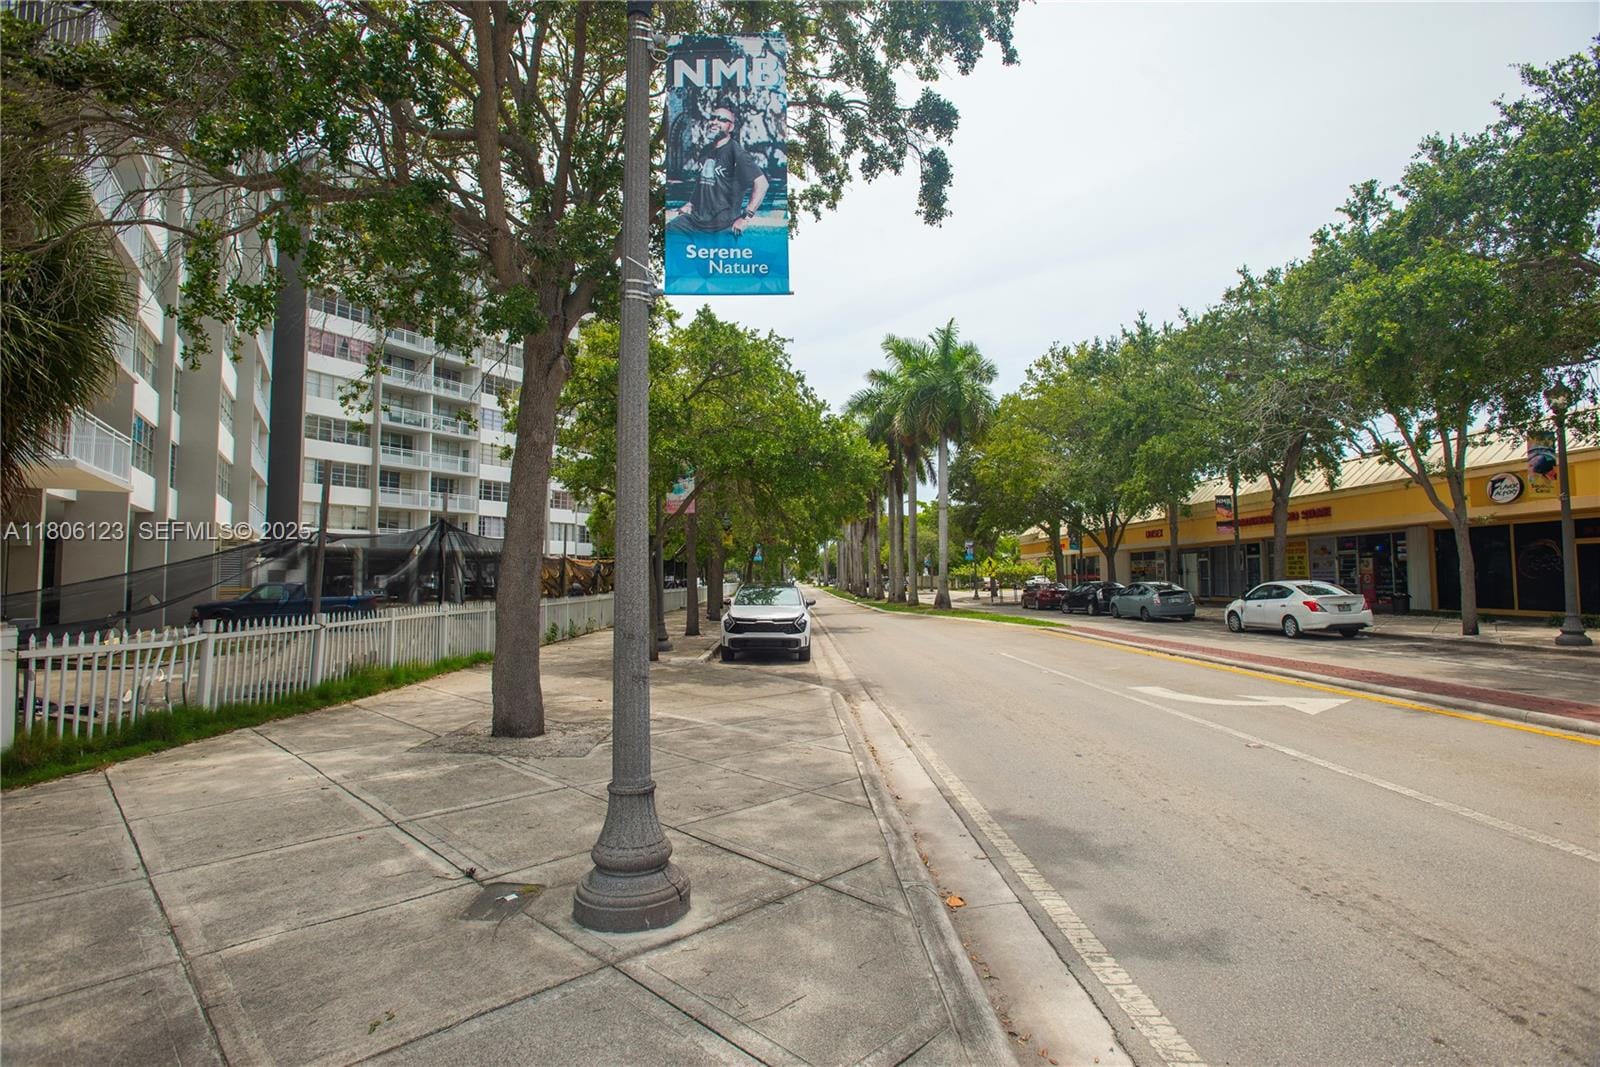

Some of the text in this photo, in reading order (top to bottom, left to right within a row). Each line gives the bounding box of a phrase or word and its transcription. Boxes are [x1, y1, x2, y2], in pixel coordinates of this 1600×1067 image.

[673, 58, 781, 88] NMB
[686, 244, 753, 259] Serene
[709, 260, 769, 274] Nature
